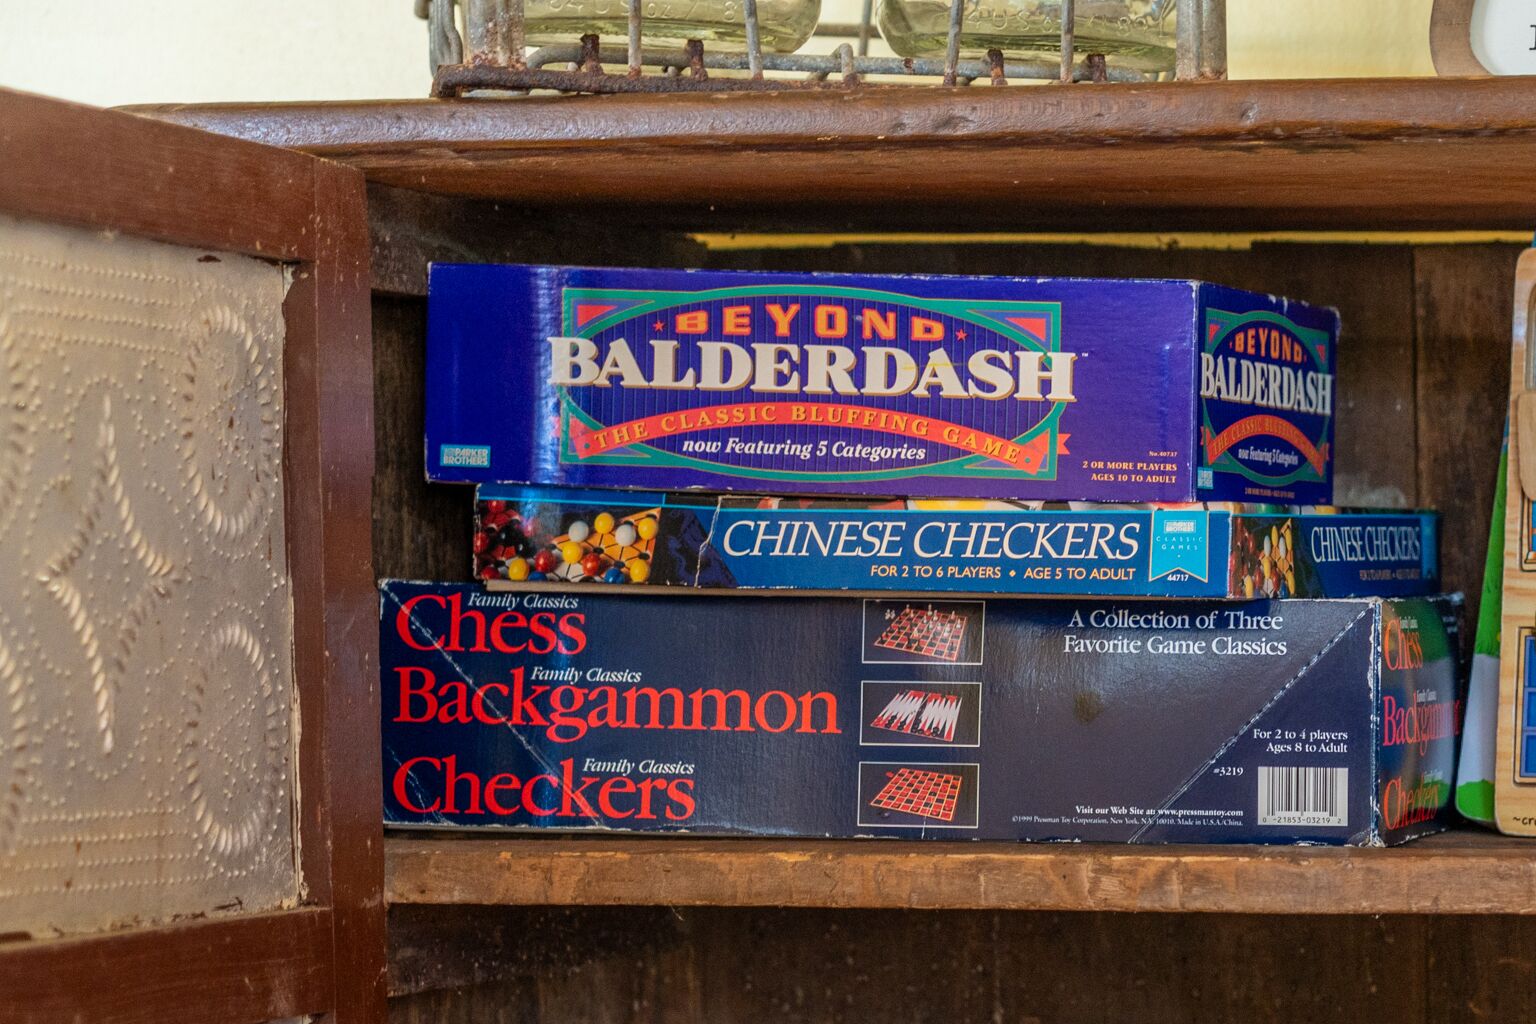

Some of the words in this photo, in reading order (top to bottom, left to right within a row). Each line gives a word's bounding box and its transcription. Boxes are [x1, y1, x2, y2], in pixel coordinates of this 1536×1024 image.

[675, 303, 946, 342] BEYOND
[1234, 328, 1304, 363] BEYOND
[547, 335, 1078, 403] BALDERDASH
[1201, 352, 1332, 416] BALDERDASH
[594, 421, 650, 449] THE
[660, 404, 778, 433] CLASSIC
[791, 404, 931, 438] BLUFFING
[942, 424, 1021, 464] GAME
[682, 440, 723, 453] now
[725, 437, 813, 460] Featuring
[816, 440, 827, 457] 5
[831, 440, 926, 463] Categories
[442, 456, 489, 467] BROTHERS
[724, 519, 905, 558] CHINESE
[913, 520, 1141, 560] CHECKERS
[1311, 526, 1365, 562] CHINESE
[1365, 526, 1420, 562] CHECKERS
[870, 565, 898, 577] FOR
[901, 565, 910, 577] 2
[913, 565, 933, 578] TO
[935, 566, 943, 578] 6
[947, 566, 1001, 579] PLAYERS
[1023, 567, 1052, 579] AGE
[1055, 567, 1063, 579] 5
[1066, 567, 1087, 580] TO
[1089, 568, 1136, 580] ADULT
[468, 592, 520, 610] Family
[523, 593, 579, 609] Classics
[396, 592, 587, 656] Chess
[1067, 610, 1084, 629] A
[1090, 607, 1191, 631] Collection
[1195, 610, 1218, 629] of
[1227, 610, 1283, 631] Three
[1063, 634, 1143, 654] Favorite
[1147, 636, 1206, 655] Game
[1210, 636, 1288, 657] Classics
[1384, 619, 1423, 671] Chess
[530, 665, 583, 683] Family
[586, 667, 642, 683] Classics
[393, 666, 842, 743] Backgammon
[583, 757, 636, 775] Family
[639, 759, 695, 775] Classics
[1213, 767, 1244, 776] #3219
[393, 754, 696, 820] Checkers
[1075, 805, 1093, 815] Visit
[1095, 807, 1108, 815] our
[1110, 806, 1127, 815] Web
[1129, 806, 1144, 815] Site
[1158, 807, 1244, 817] www.pressmantoy.com
